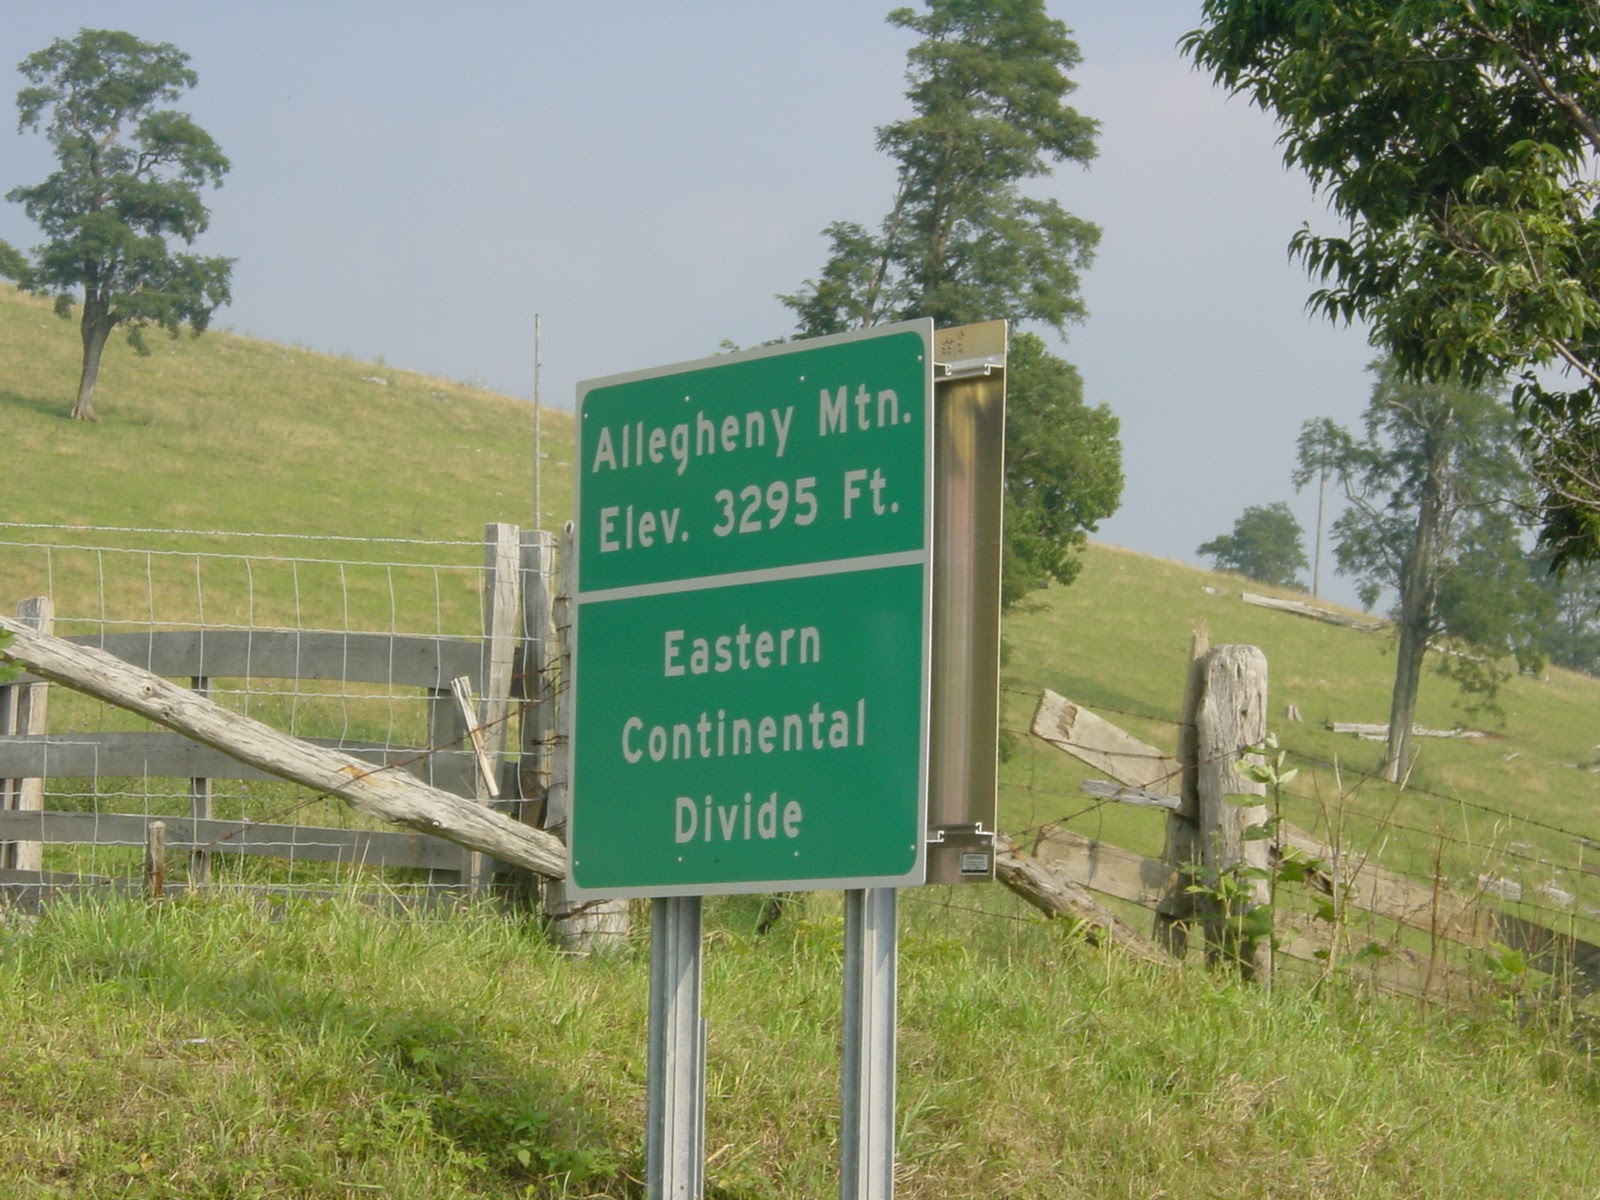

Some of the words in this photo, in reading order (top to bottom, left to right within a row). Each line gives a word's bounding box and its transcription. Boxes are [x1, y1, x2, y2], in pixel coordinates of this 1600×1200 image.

[592, 406, 793, 476] Allegheny
[819, 383, 911, 436] Mtn.
[600, 505, 688, 553] Elev.
[713, 477, 818, 537] 3295
[844, 468, 898, 519] Ft.
[664, 624, 820, 677] Eastern
[622, 699, 865, 763] Continental
[675, 792, 802, 844] Divide
